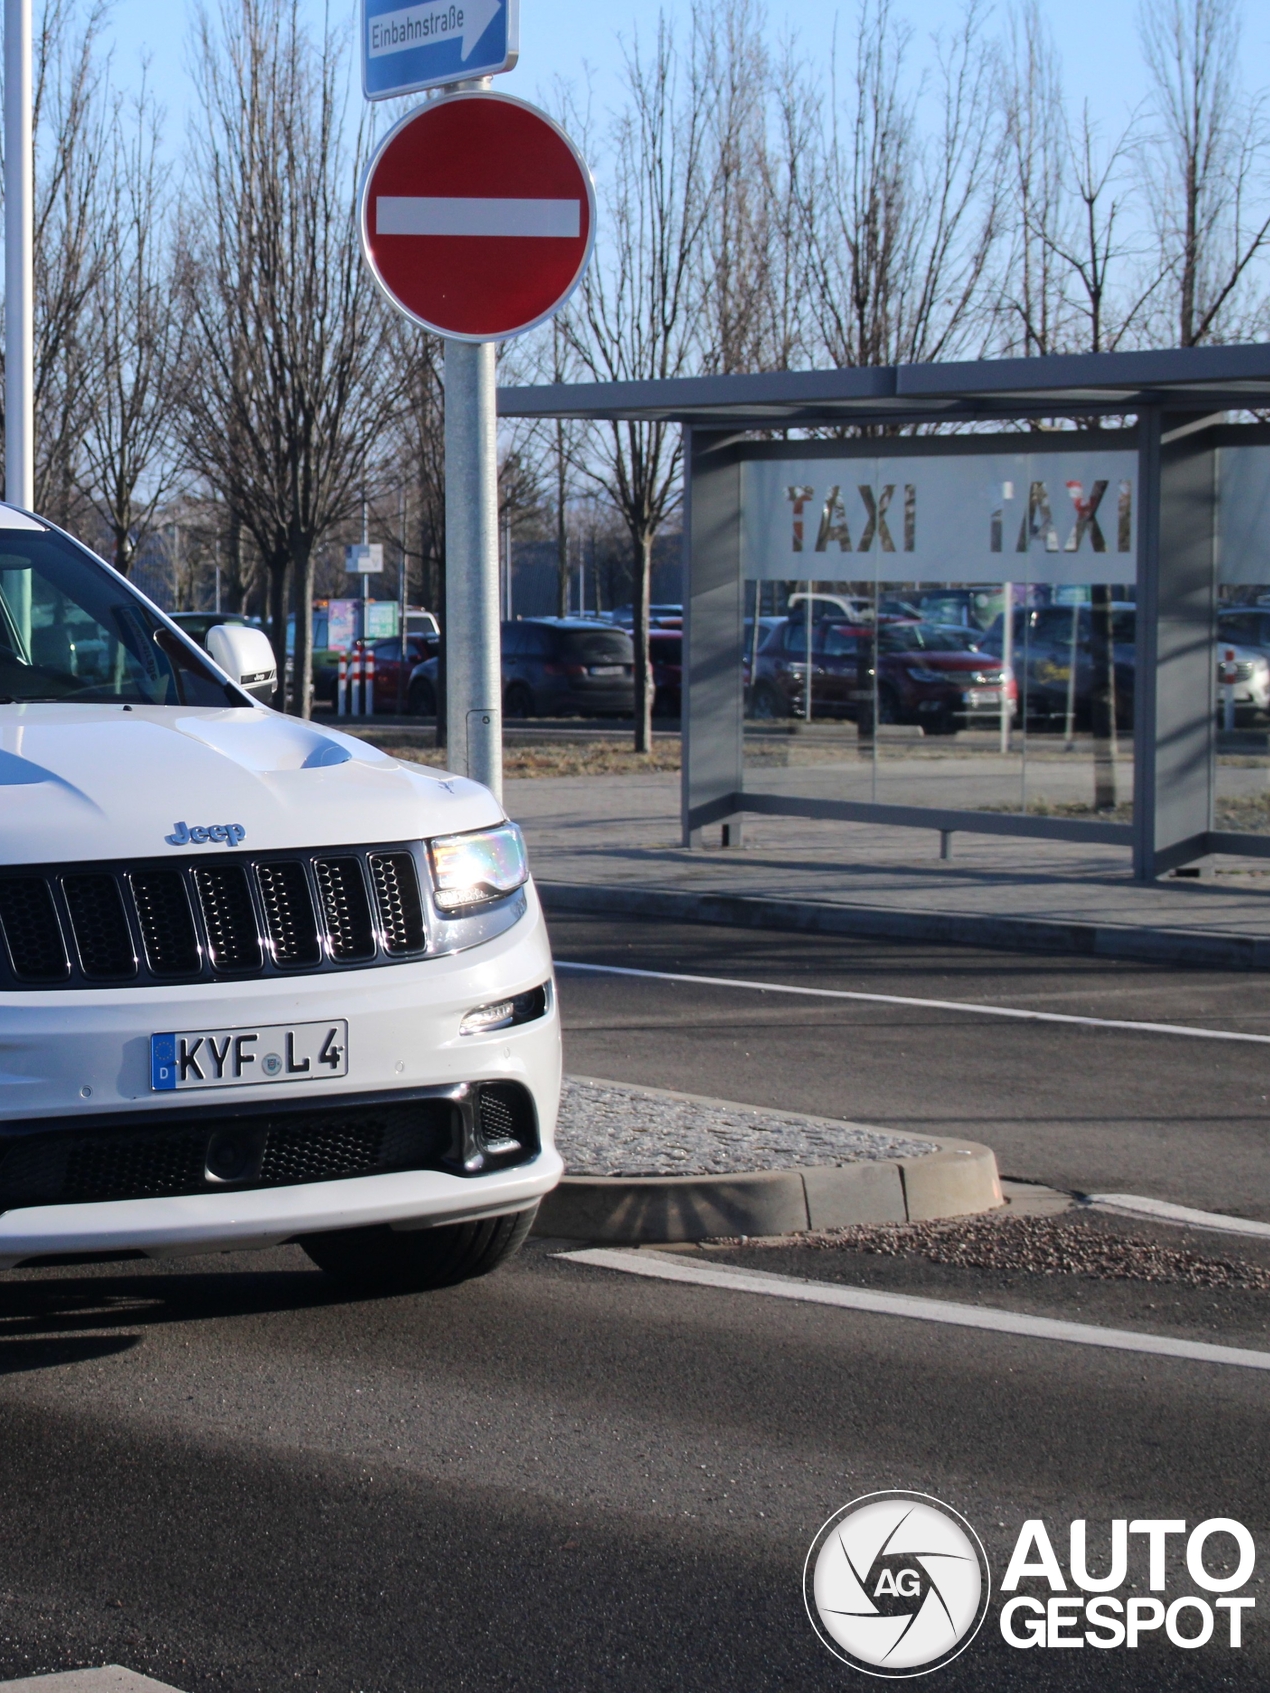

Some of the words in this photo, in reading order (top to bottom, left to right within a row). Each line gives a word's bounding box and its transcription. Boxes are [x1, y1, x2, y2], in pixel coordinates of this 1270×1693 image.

[371, 4, 465, 49] Einbahnstraße
[783, 483, 916, 552] TAXI
[164, 821, 247, 847] Jeep
[159, 1067, 169, 1080] D
[180, 1033, 258, 1081] KYF
